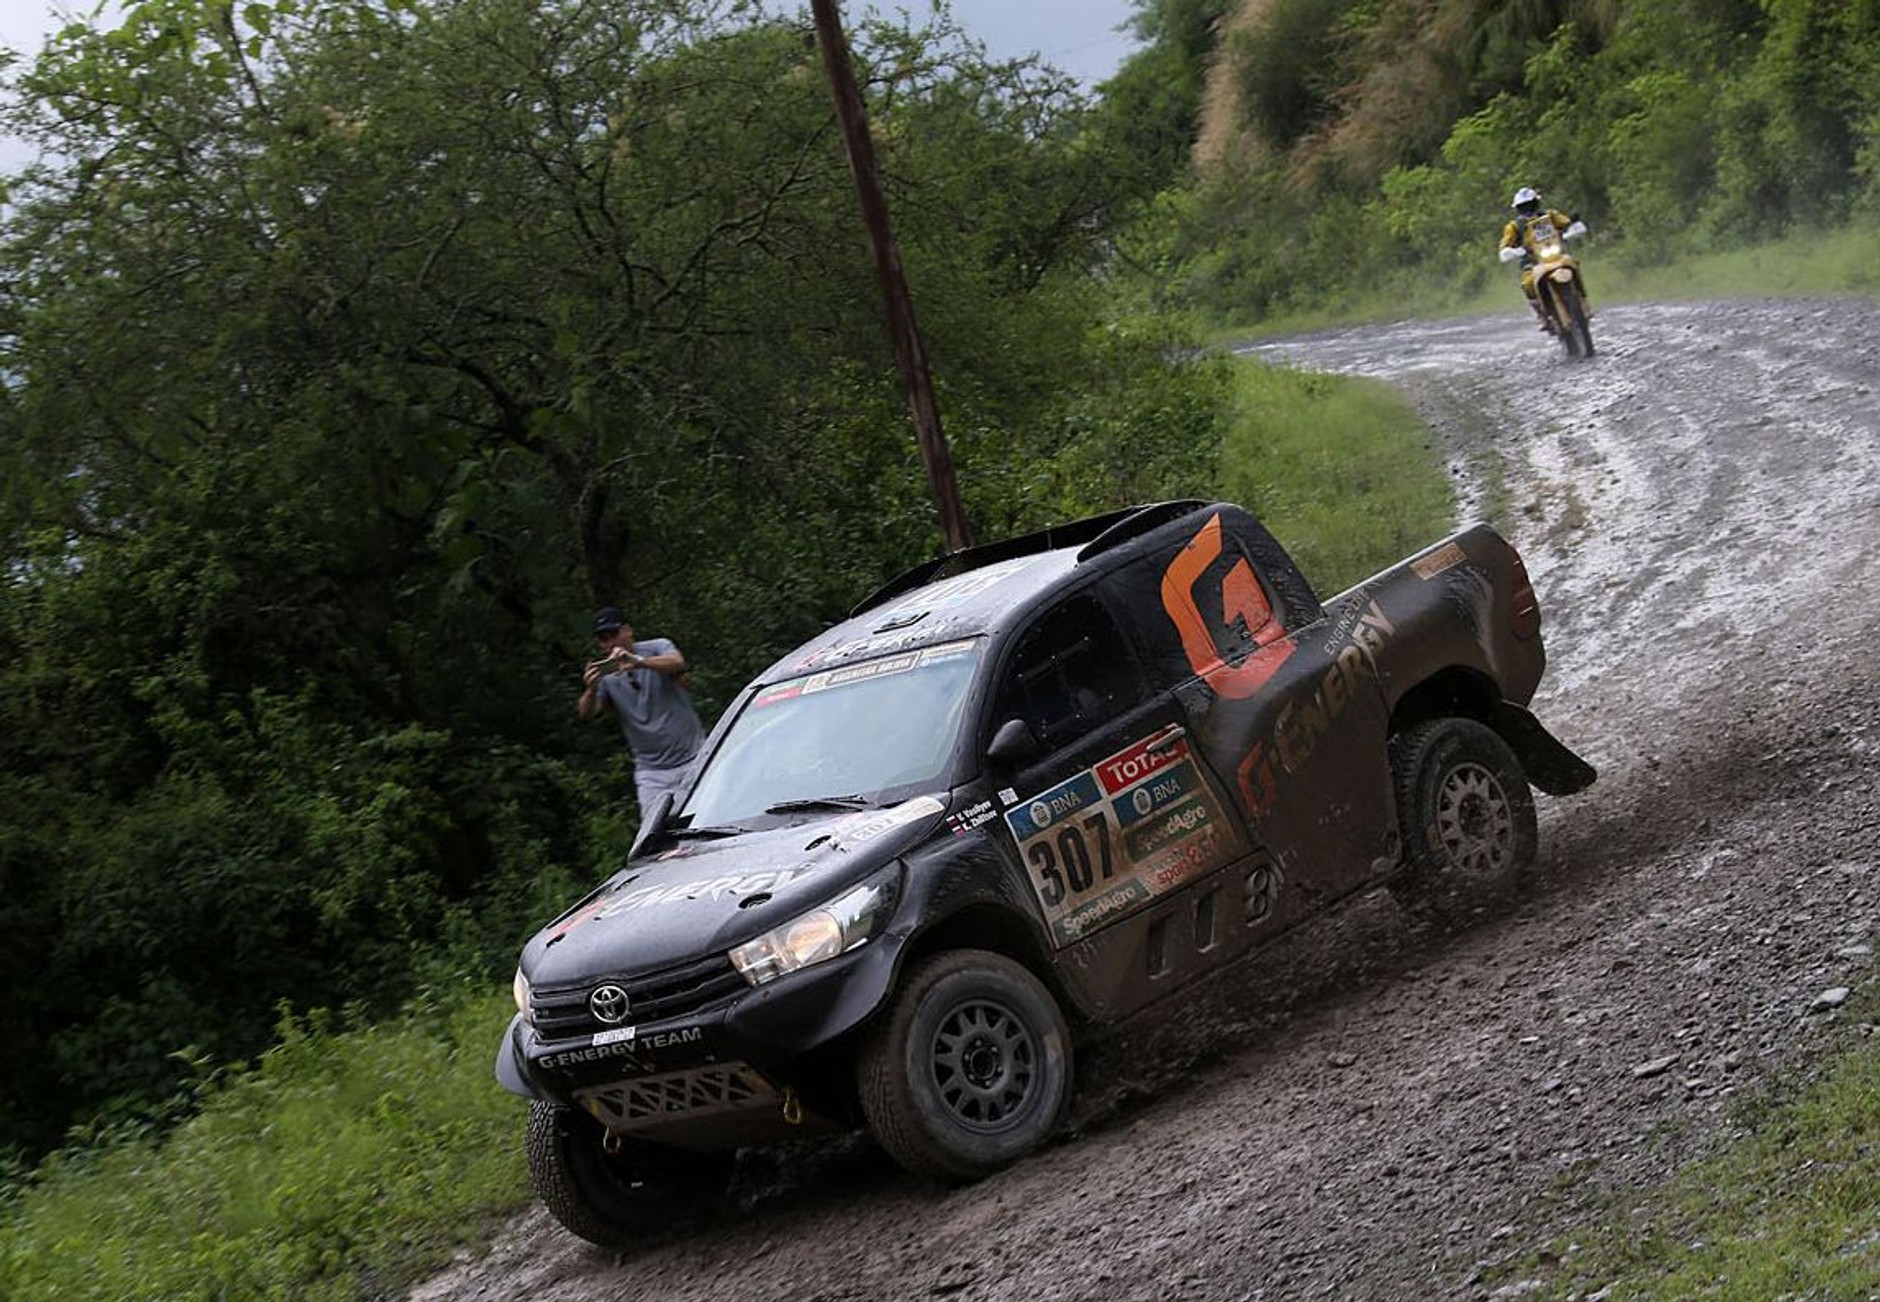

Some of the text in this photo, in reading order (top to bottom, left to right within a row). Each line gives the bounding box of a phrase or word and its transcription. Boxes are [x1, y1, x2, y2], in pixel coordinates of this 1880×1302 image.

[1325, 606, 1357, 656] ENGINE
[1107, 745, 1179, 784] TOTA
[1051, 790, 1083, 815] BNA
[1153, 779, 1181, 802] BNA
[1028, 813, 1113, 908] 307
[1063, 887, 1137, 935] SpeedAgro
[641, 1027, 703, 1049] TEAM
